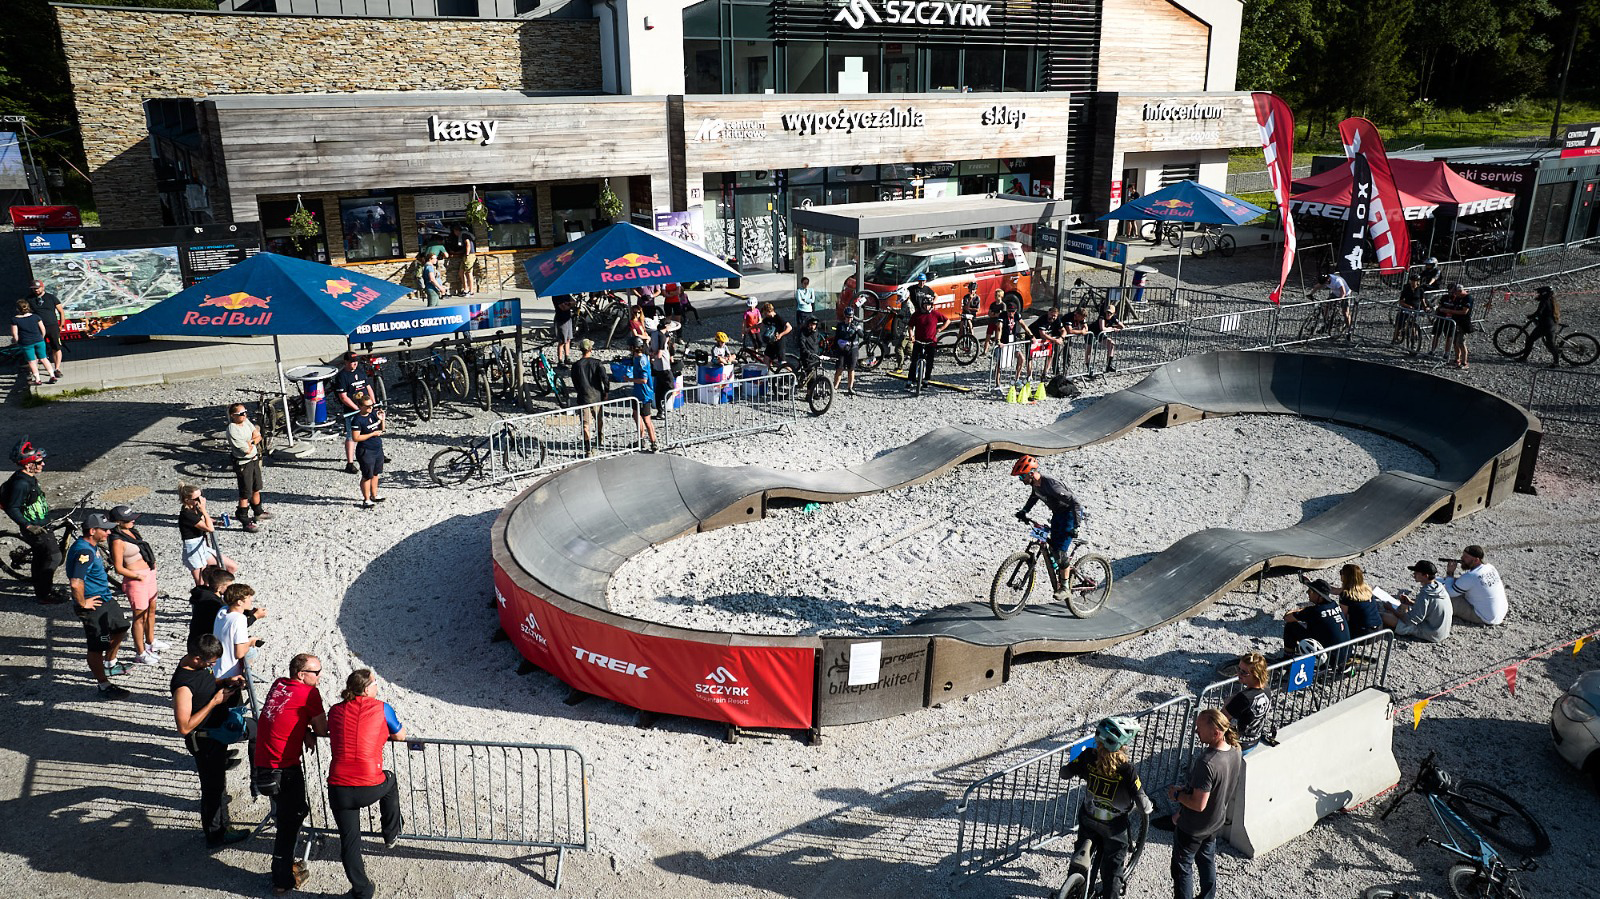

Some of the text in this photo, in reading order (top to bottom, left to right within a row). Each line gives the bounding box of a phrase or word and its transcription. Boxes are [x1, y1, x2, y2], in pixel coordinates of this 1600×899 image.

[885, 1, 992, 26] SZCZYRK
[784, 107, 926, 135] wypożyczalnia
[983, 105, 1027, 129] sklep
[1144, 103, 1224, 121] infocentrum
[430, 114, 499, 145] kasy
[1459, 169, 1523, 183] ski serwis
[1143, 207, 1195, 217] Red Bull
[1458, 194, 1516, 217] TREK
[600, 265, 672, 283] Red Bull
[339, 285, 382, 311] Red Bull
[66, 322, 87, 331] FREE
[182, 311, 273, 326] Red Bull
[356, 325, 371, 335] RED
[372, 323, 390, 333] BULL
[390, 320, 411, 331] DODA
[571, 645, 652, 679] TREK
[695, 683, 749, 697] SZCZYRK
[696, 693, 750, 705] Mountain Resort
